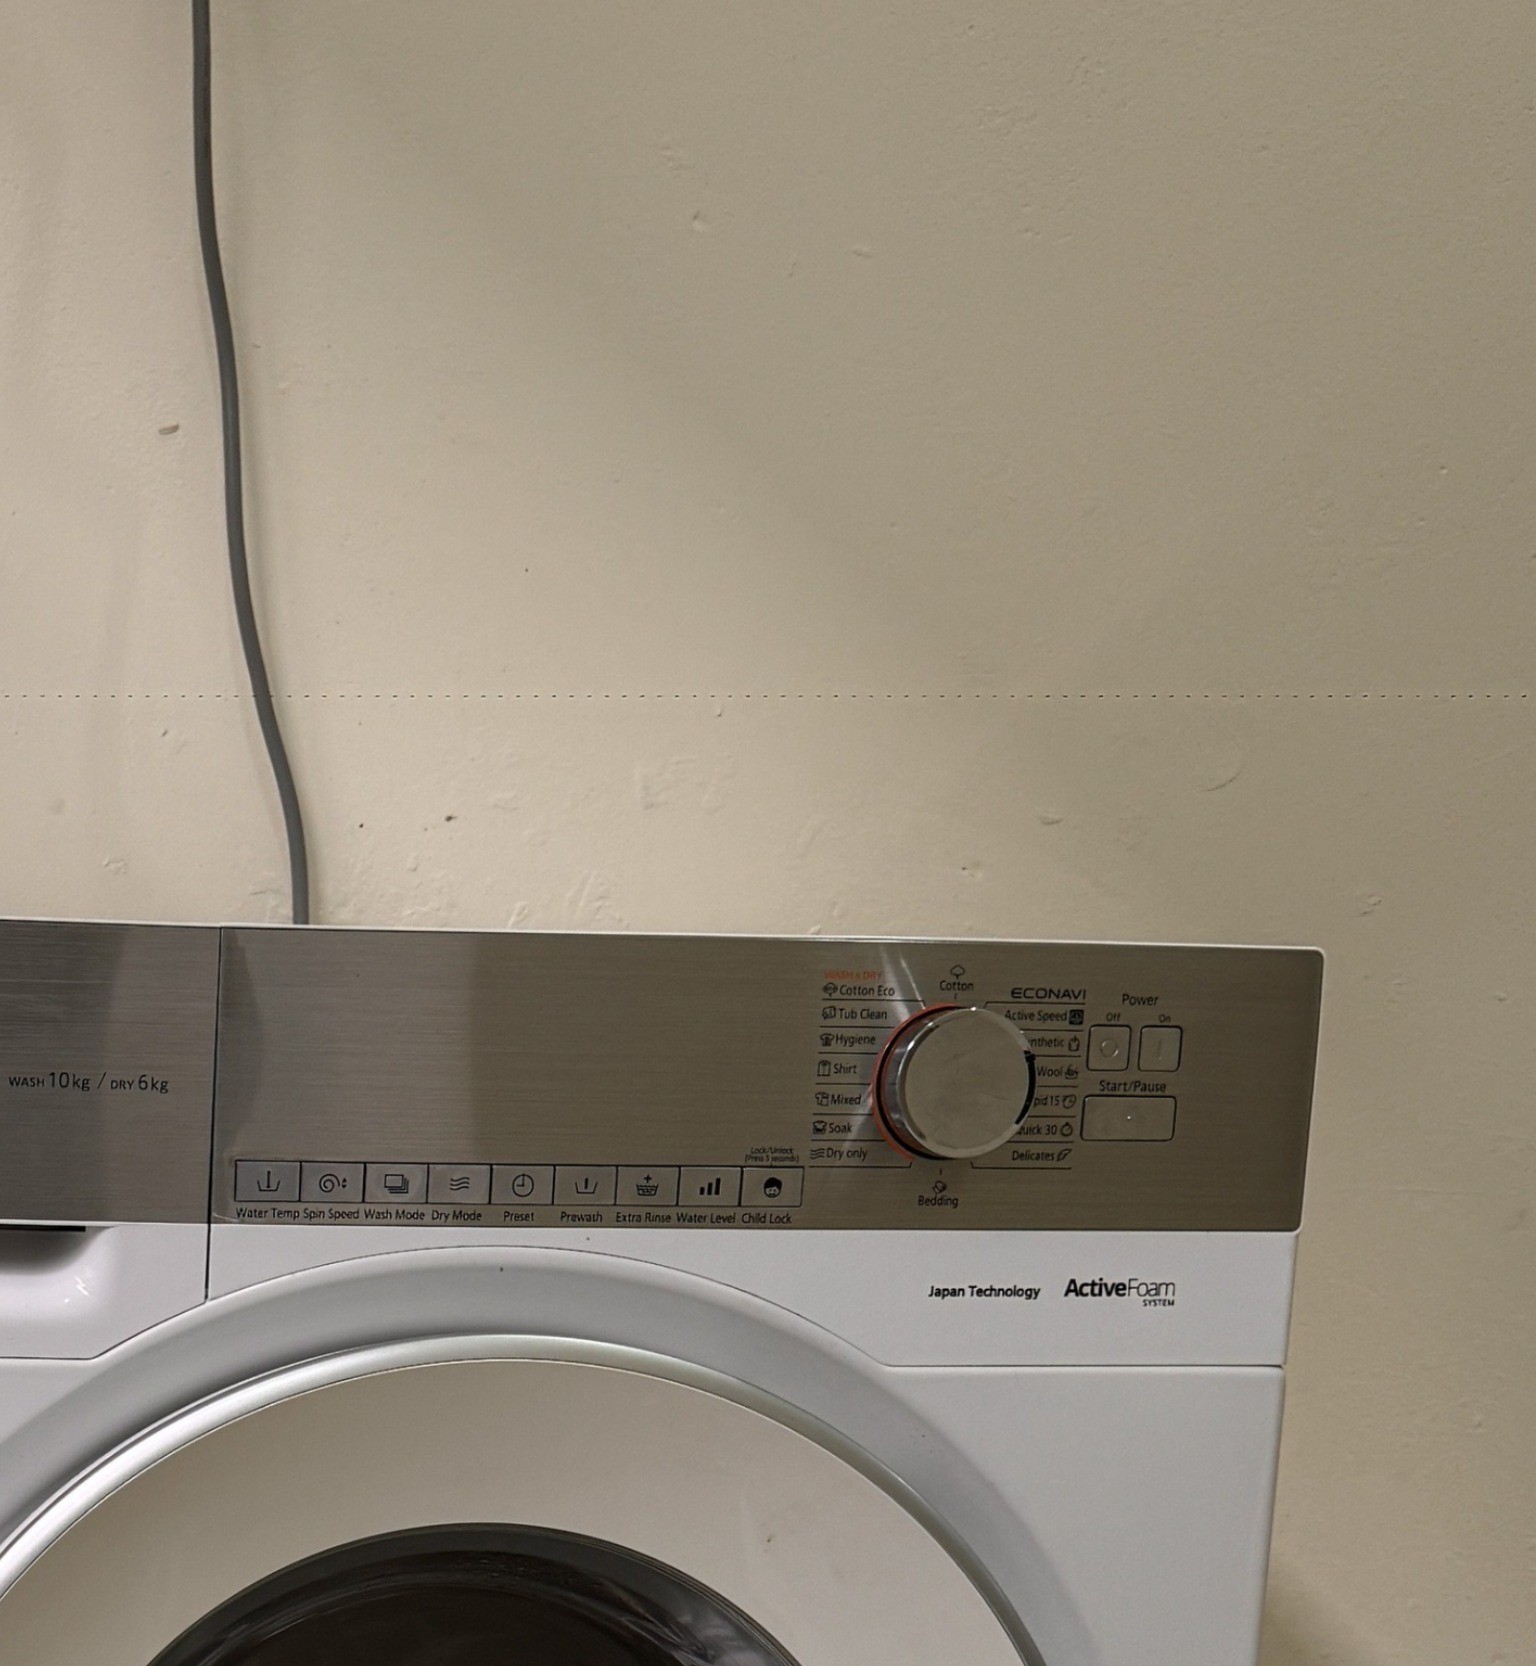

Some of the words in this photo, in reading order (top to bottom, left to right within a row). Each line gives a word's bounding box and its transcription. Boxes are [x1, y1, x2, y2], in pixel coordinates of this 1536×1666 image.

[839, 985, 876, 997] Cotton
[877, 986, 896, 997] Eco
[939, 980, 974, 991] Cotton
[1010, 987, 1087, 1000] ECONAVI
[1122, 993, 1159, 1007] Power
[839, 1008, 856, 1020] Tub
[859, 1009, 888, 1020] Clean
[1005, 1010, 1035, 1021] Active
[1037, 1010, 1067, 1022] Speed
[1106, 1012, 1121, 1022] Off
[1158, 1014, 1171, 1023] On
[835, 1034, 876, 1048] Hygiene
[1028, 1037, 1065, 1048] nthetic
[833, 1063, 858, 1075] Shirt
[1037, 1066, 1063, 1077] Wool
[8, 1075, 46, 1088] WASH
[48, 1071, 91, 1093] 10kg
[110, 1078, 135, 1091] DRY
[137, 1073, 169, 1094] 6kg
[1099, 1080, 1167, 1093] Start/Pause
[830, 1094, 862, 1105] Mixed
[1049, 1095, 1060, 1106] 15
[828, 1122, 852, 1134] Soak
[1044, 1125, 1057, 1136] 30
[826, 1148, 844, 1161] Dry
[846, 1148, 868, 1161] only
[1012, 1150, 1055, 1161] Delicates
[917, 1196, 959, 1208] Bedding
[235, 1207, 268, 1220] Water
[271, 1208, 300, 1222] Temp
[303, 1207, 326, 1222] Spin
[328, 1208, 360, 1222] Speed
[364, 1208, 391, 1221] Wash
[395, 1208, 426, 1221] Mode
[431, 1209, 450, 1223] Dry
[452, 1210, 482, 1222] Mode
[503, 1211, 534, 1223] Preset
[560, 1211, 603, 1223] Prewash
[616, 1212, 642, 1223] Extra
[644, 1212, 672, 1224] Rinse
[676, 1212, 707, 1224] Water
[710, 1212, 736, 1224] Level
[741, 1212, 766, 1224] Child
[769, 1212, 792, 1225] Lock
[928, 1285, 965, 1300] Japan
[968, 1285, 1041, 1300] Technology
[1064, 1278, 1176, 1298] ActiveFoam
[1142, 1299, 1175, 1307] SYSTEM
